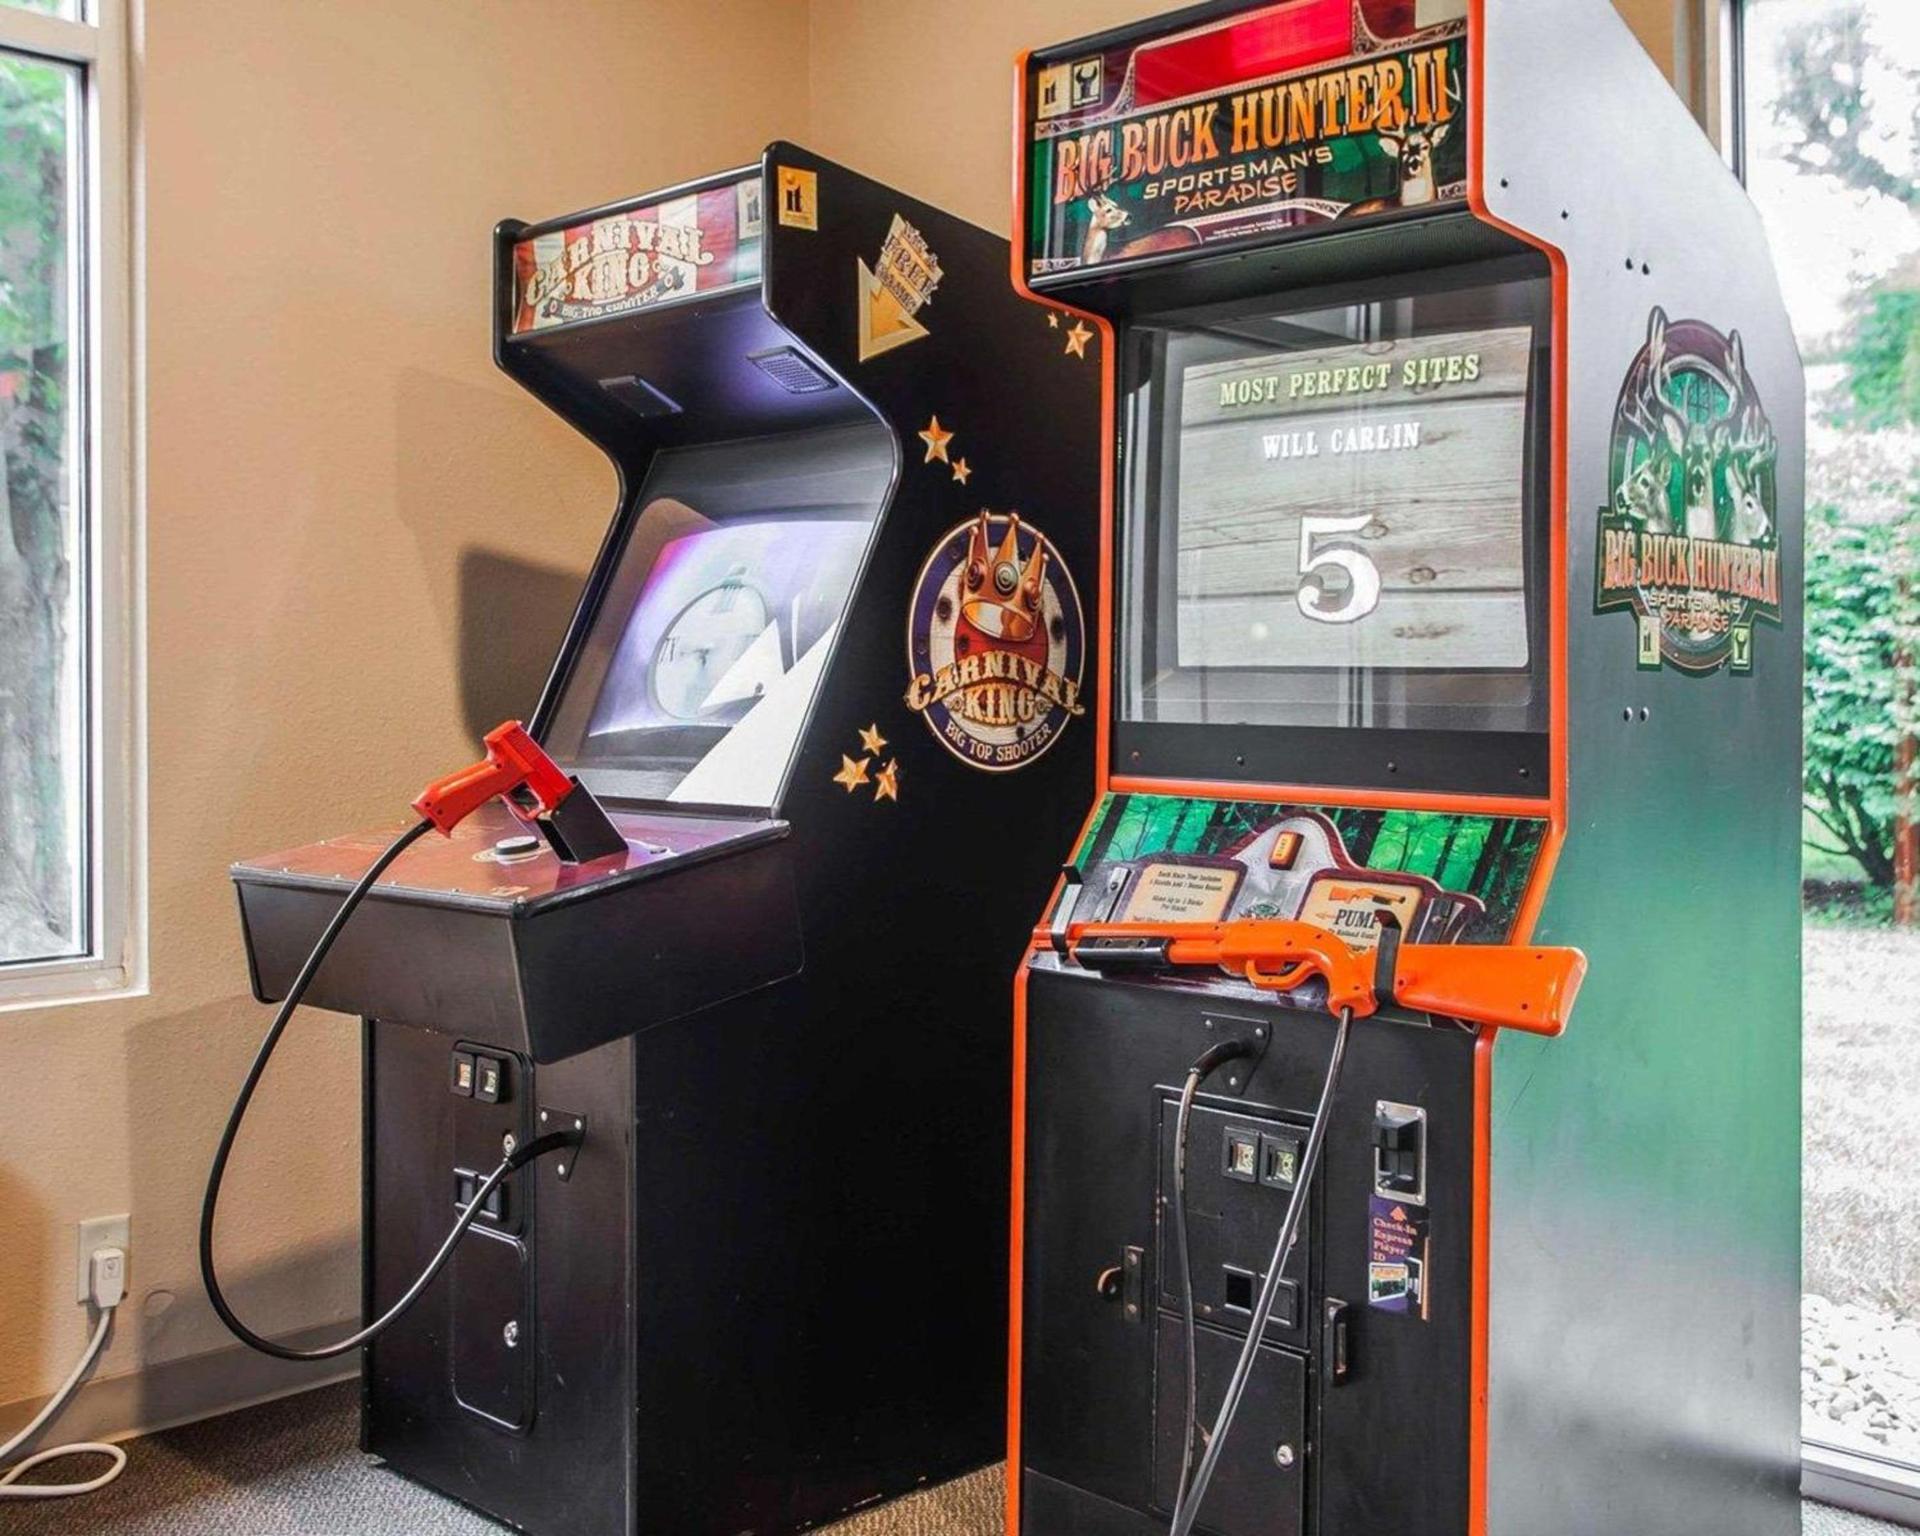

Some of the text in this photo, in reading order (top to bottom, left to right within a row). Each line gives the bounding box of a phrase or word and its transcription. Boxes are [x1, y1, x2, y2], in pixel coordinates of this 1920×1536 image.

[1054, 128, 1112, 204] BIG
[1120, 102, 1219, 181] BUCK
[1230, 59, 1407, 153] HUNTER
[1143, 146, 1333, 199] SPORTSMAN'S
[1174, 172, 1297, 214] PARADISE
[525, 220, 715, 306] CARNIVAL
[571, 249, 650, 302] KING
[1219, 353, 1480, 406] MOST PERFECT SITES
[1262, 422, 1422, 459] WILL CARLIN
[1296, 513, 1382, 625] 5
[1603, 529, 1636, 589] BIG
[1640, 533, 1689, 587] BUCK
[1662, 610, 1730, 632] PARADISE
[905, 650, 1086, 715] CARNIVAL
[963, 684, 1037, 725] KING
[944, 720, 1053, 763] BIG TOP SHOOTER
[1373, 1228, 1414, 1246] Express
